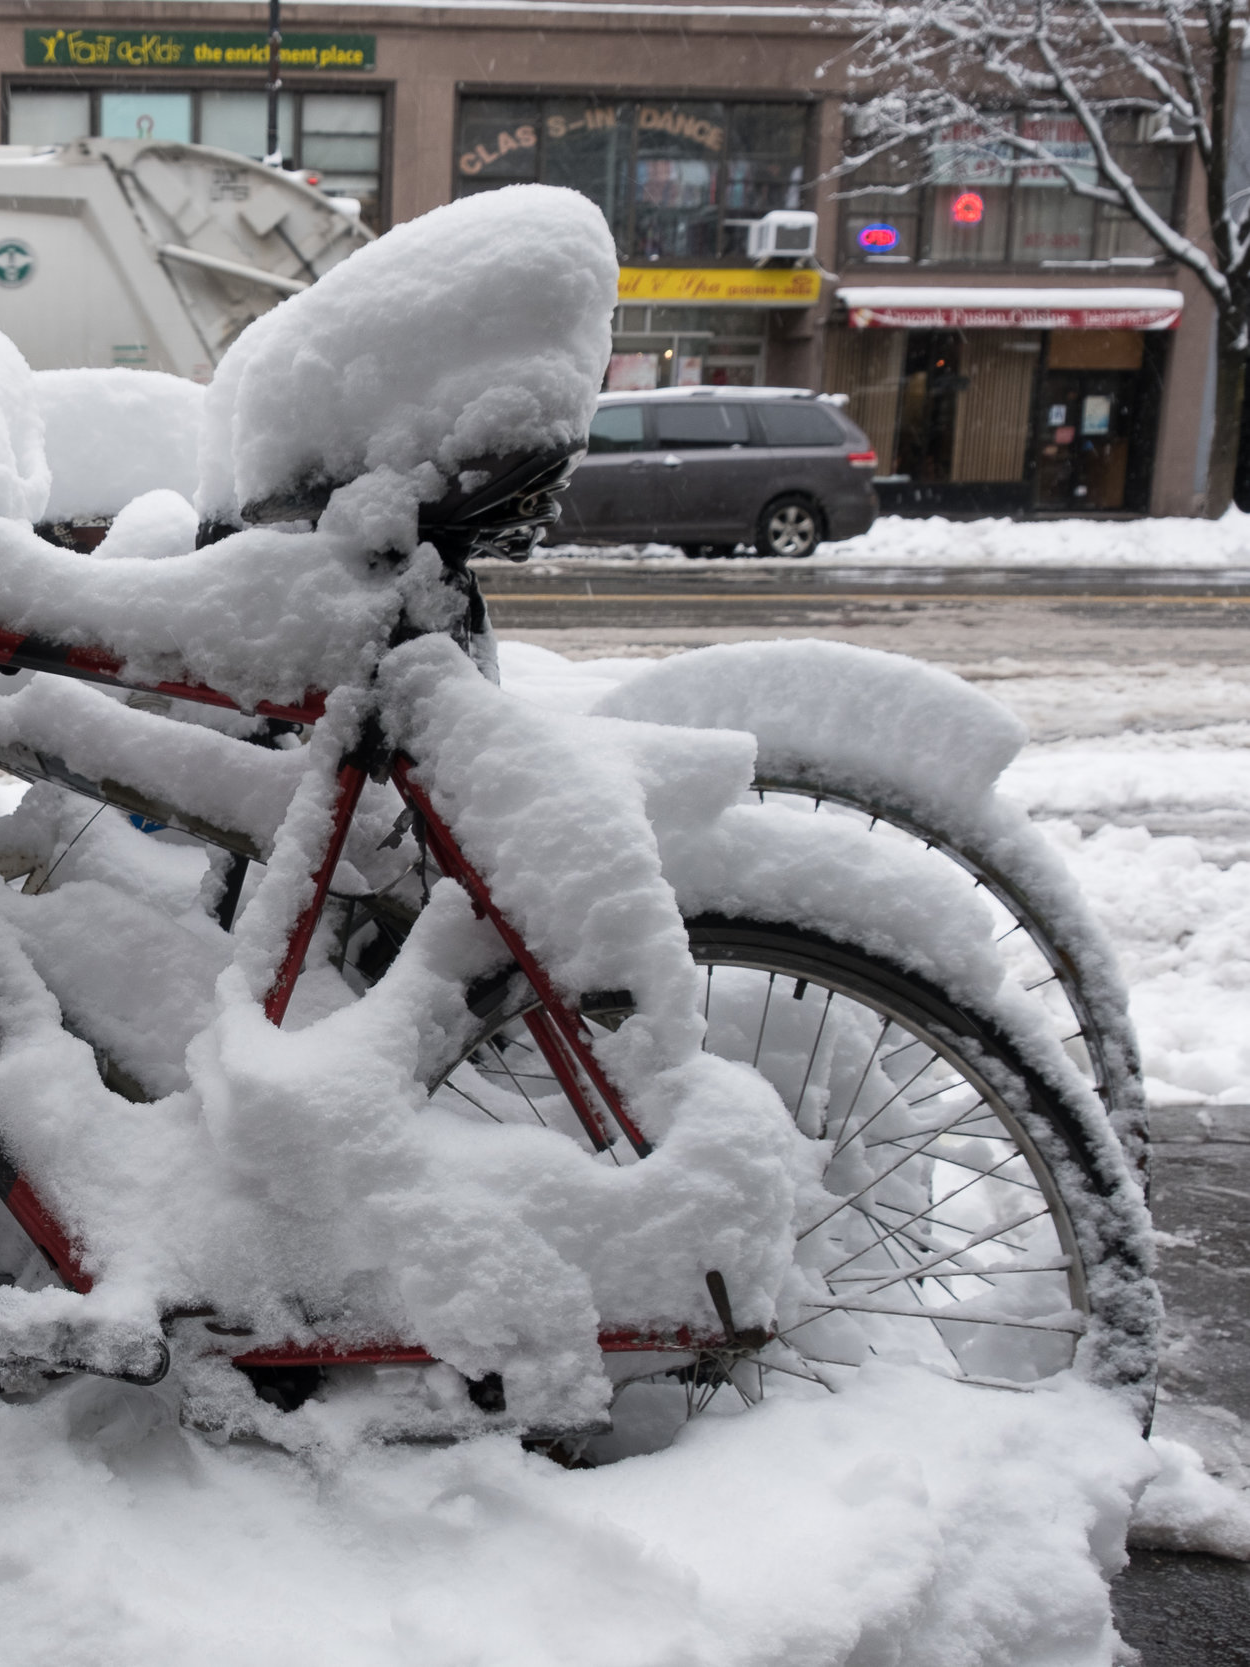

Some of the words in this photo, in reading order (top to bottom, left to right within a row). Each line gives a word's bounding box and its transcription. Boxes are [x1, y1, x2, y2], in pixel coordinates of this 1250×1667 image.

[194, 43, 222, 62] the
[319, 45, 364, 67] place
[638, 105, 724, 150] DANCE
[951, 308, 1007, 326] Fusion
[1013, 308, 1070, 326] Cuisine
